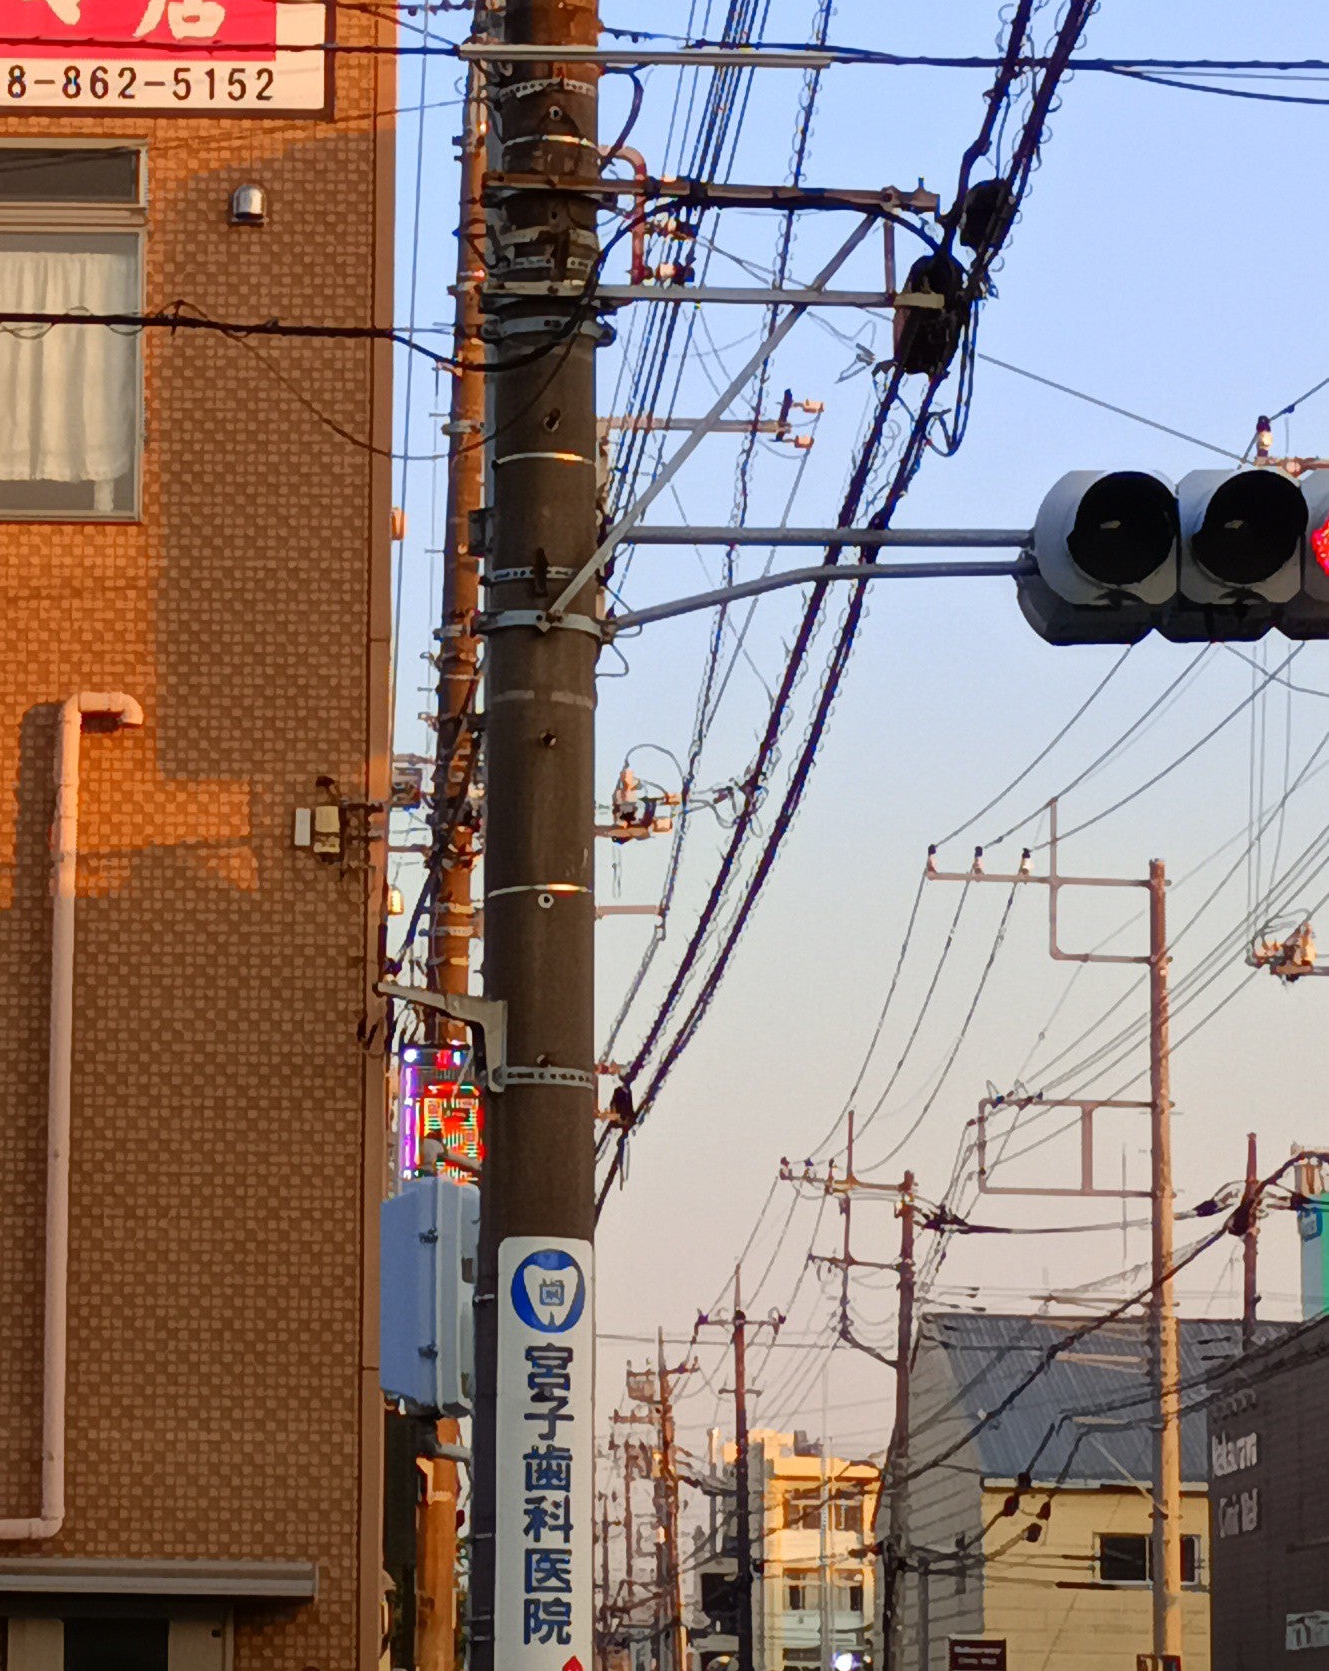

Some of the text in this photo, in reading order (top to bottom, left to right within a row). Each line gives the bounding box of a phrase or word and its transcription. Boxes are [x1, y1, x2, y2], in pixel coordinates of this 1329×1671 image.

[523, 1342, 574, 1646] 宮子歯科医院
